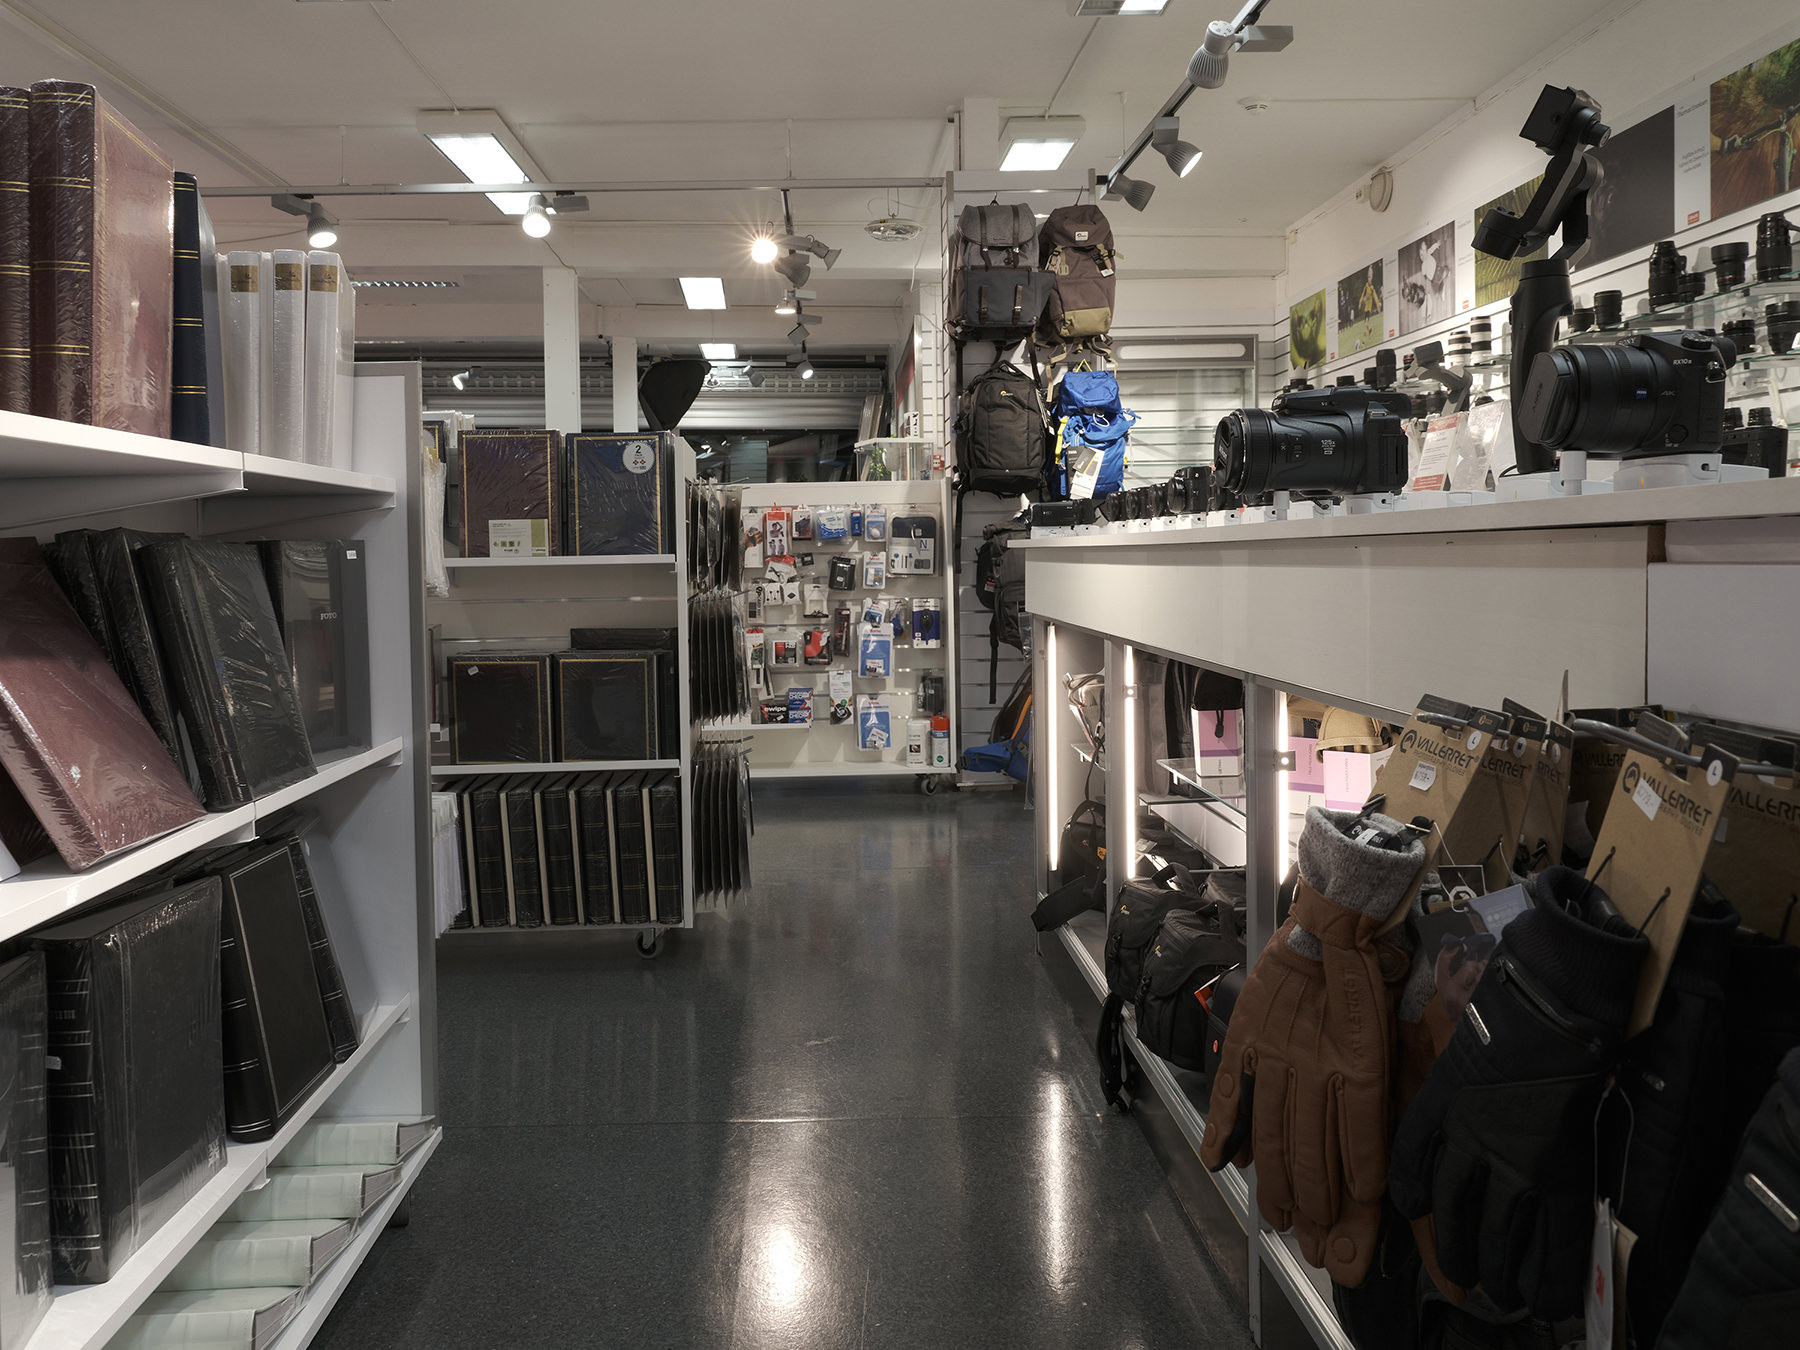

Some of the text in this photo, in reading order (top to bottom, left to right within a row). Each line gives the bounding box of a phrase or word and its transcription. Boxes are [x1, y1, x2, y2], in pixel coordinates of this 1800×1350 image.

[1618, 337, 1636, 346] SONY
[635, 444, 642, 454] 2
[920, 539, 928, 549] N
[320, 612, 337, 620] FOTO
[1417, 736, 1475, 769] VALLERRET
[1712, 766, 1717, 776] L
[1642, 771, 1713, 827] VALLERRET
